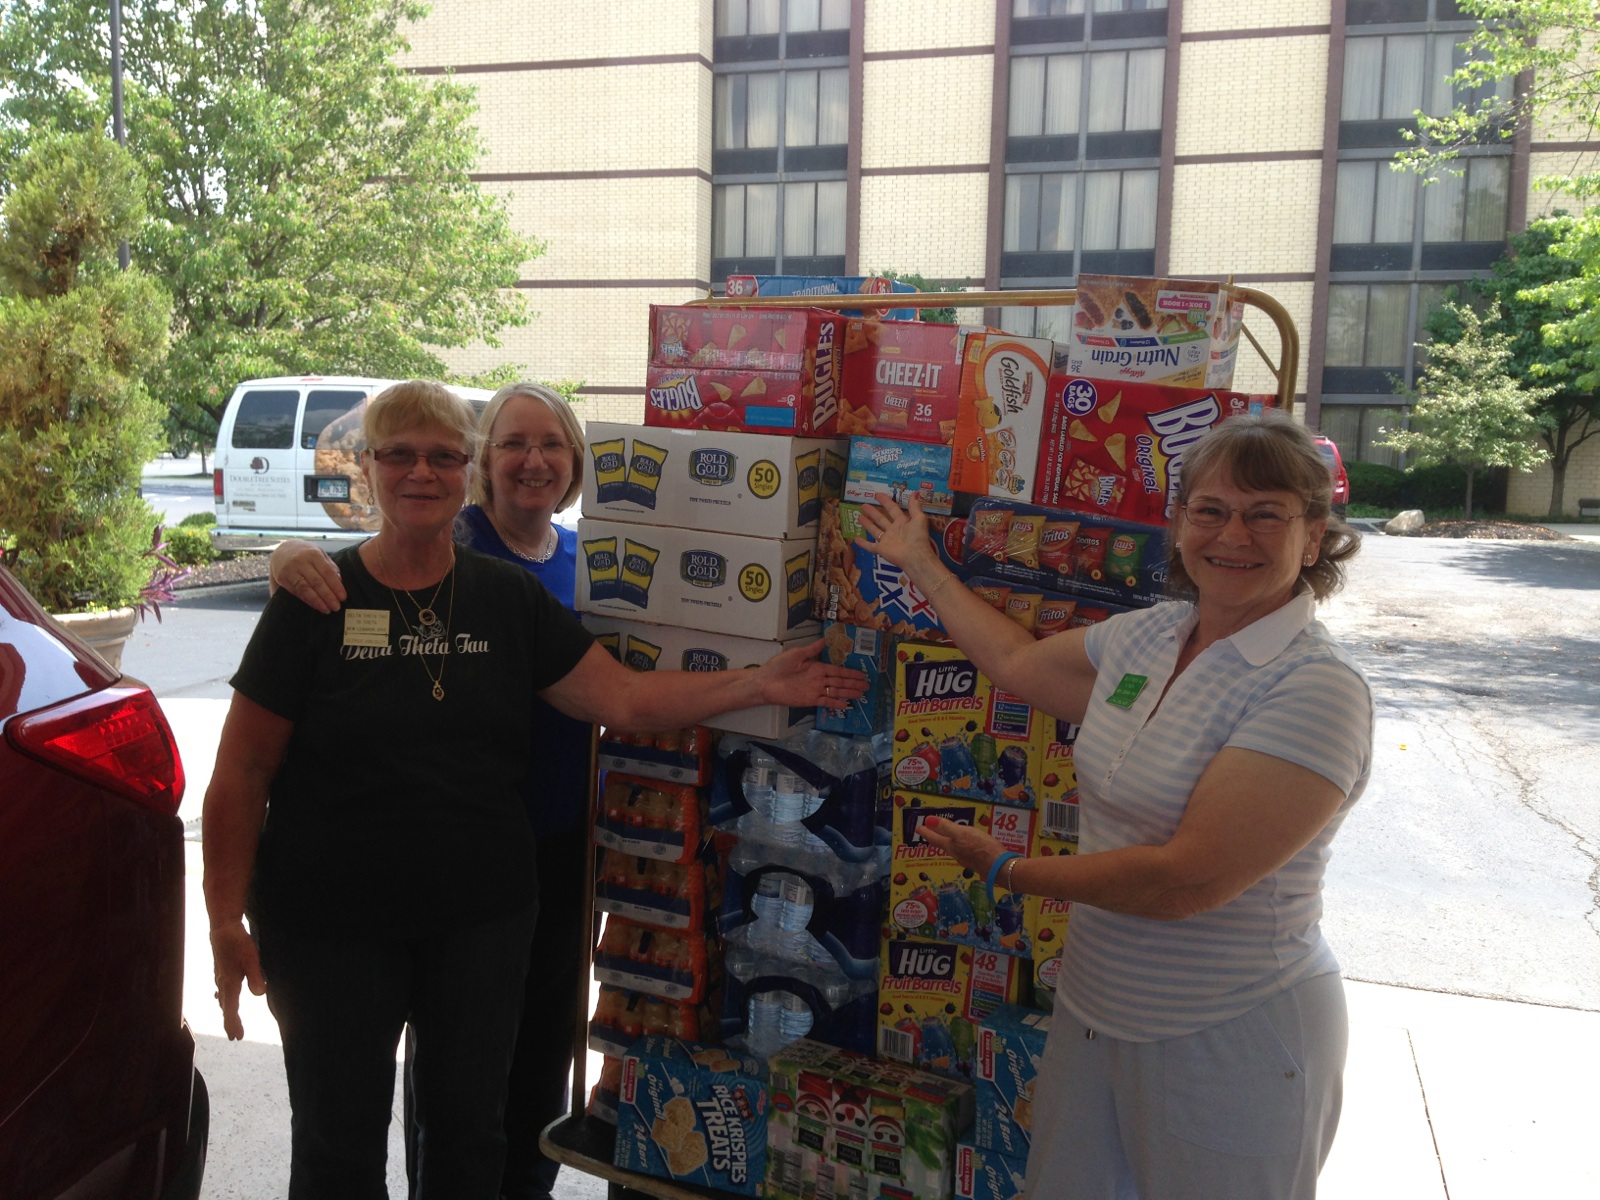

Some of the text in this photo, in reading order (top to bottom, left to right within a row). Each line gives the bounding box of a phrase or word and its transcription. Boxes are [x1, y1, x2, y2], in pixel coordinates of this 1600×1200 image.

[728, 280, 743, 295] 36
[791, 282, 839, 296] TRADITIONAL
[1091, 346, 1180, 366] Nutri Grain
[812, 321, 839, 433] BUGLES
[1071, 364, 1081, 373] 36
[650, 374, 704, 412] BUGLES
[1000, 357, 1023, 414] Goldfish
[1067, 385, 1076, 408] BAGS
[1075, 385, 1092, 411] 30
[915, 403, 932, 417] 36
[700, 453, 727, 465] ROLD
[874, 454, 899, 467] TREATS
[696, 463, 728, 477] GOLD
[754, 467, 774, 483] 50
[754, 482, 774, 492] Singles
[1096, 476, 1115, 506] BUGLES
[1042, 530, 1069, 544] Fritos
[1076, 537, 1100, 546] Doritos
[691, 554, 718, 567] ROLD
[687, 564, 719, 579] GOLD
[745, 570, 765, 587] 50
[745, 586, 764, 595] Singles
[1041, 609, 1066, 621] Fritos
[398, 634, 451, 656] Theta
[455, 633, 491, 654] Tau
[689, 662, 720, 672] GOLD
[692, 653, 719, 665] ROLD
[939, 665, 958, 673] Little
[914, 669, 974, 697] HUG
[897, 698, 930, 716] Fruit
[930, 695, 984, 712] Barrels
[994, 814, 1019, 831] 48
[894, 844, 927, 860] Fruit
[898, 949, 952, 976] HUG
[975, 952, 998, 971] 48
[881, 975, 912, 990] Fruit
[912, 977, 962, 995] Barrels
[1006, 1048, 1031, 1102] Original
[646, 1074, 667, 1120] Original
[696, 1097, 730, 1170] TREATS
[712, 1085, 747, 1183] RICE KRISPIES
[993, 1101, 1013, 1152] 24 Bars
[633, 1123, 649, 1168] 24 Bars
